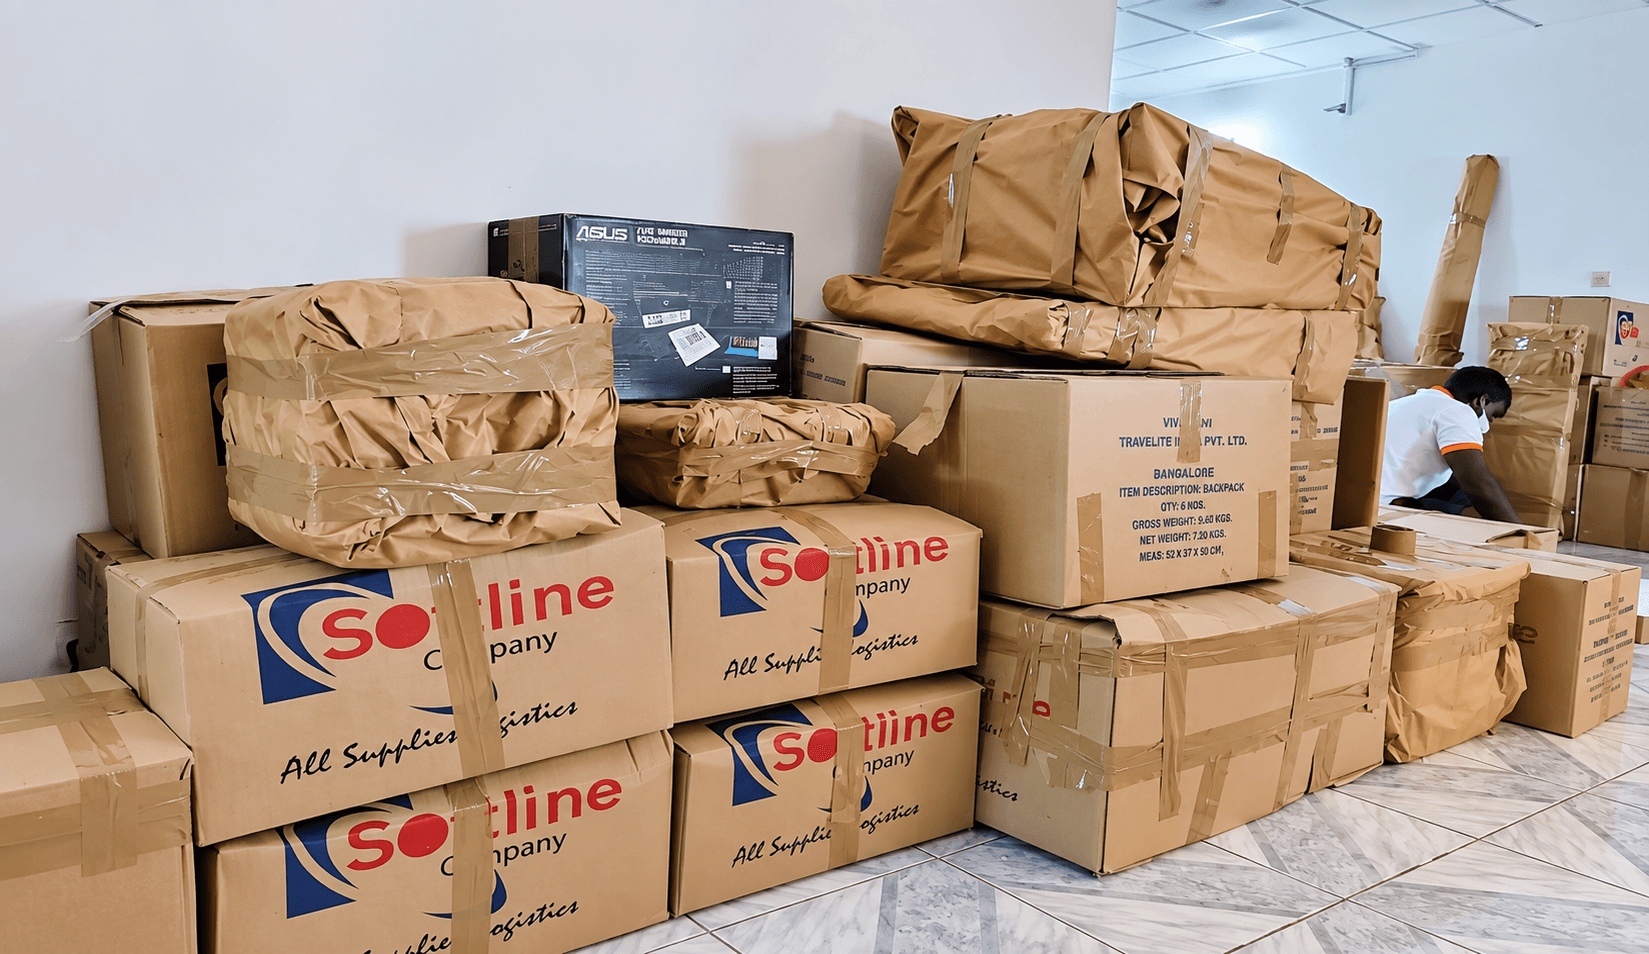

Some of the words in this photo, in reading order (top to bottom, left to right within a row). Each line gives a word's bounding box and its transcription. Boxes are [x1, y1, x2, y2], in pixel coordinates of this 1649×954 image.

[576, 226, 628, 241] ASUS
[1119, 436, 1172, 447] TRAVELITE
[1204, 436, 1225, 446] PVT.
[1227, 436, 1248, 446] LTD.
[1153, 467, 1215, 479] BANGALORE
[1119, 486, 1141, 498] ITEM
[1142, 485, 1202, 497] DESCRIPTION:
[1203, 483, 1245, 494] BACKPACK
[1160, 502, 1180, 512] QTY:
[1180, 501, 1186, 511] 6
[1187, 500, 1206, 510] NOS.
[1132, 519, 1161, 531] GROSS
[1163, 516, 1197, 528] WEIGHT:
[1215, 513, 1233, 523] KGS.
[1139, 535, 1156, 546] NET
[1158, 532, 1191, 544] WEIGHT:
[1209, 529, 1227, 539] KGS.
[1139, 551, 1165, 562] MEAS:
[1165, 550, 1176, 560] 52
[1176, 549, 1182, 559] X
[1183, 548, 1193, 558] 37
[1193, 547, 1199, 557] X
[724, 659, 757, 681] All
[763, 645, 823, 675] Suppli
[851, 634, 919, 661] ogistics
[280, 749, 332, 784] All
[500, 702, 579, 739] gistics
[731, 841, 764, 869] All
[769, 825, 832, 857] Supplie
[859, 804, 920, 835] ogistics
[489, 901, 580, 942] ogistics
